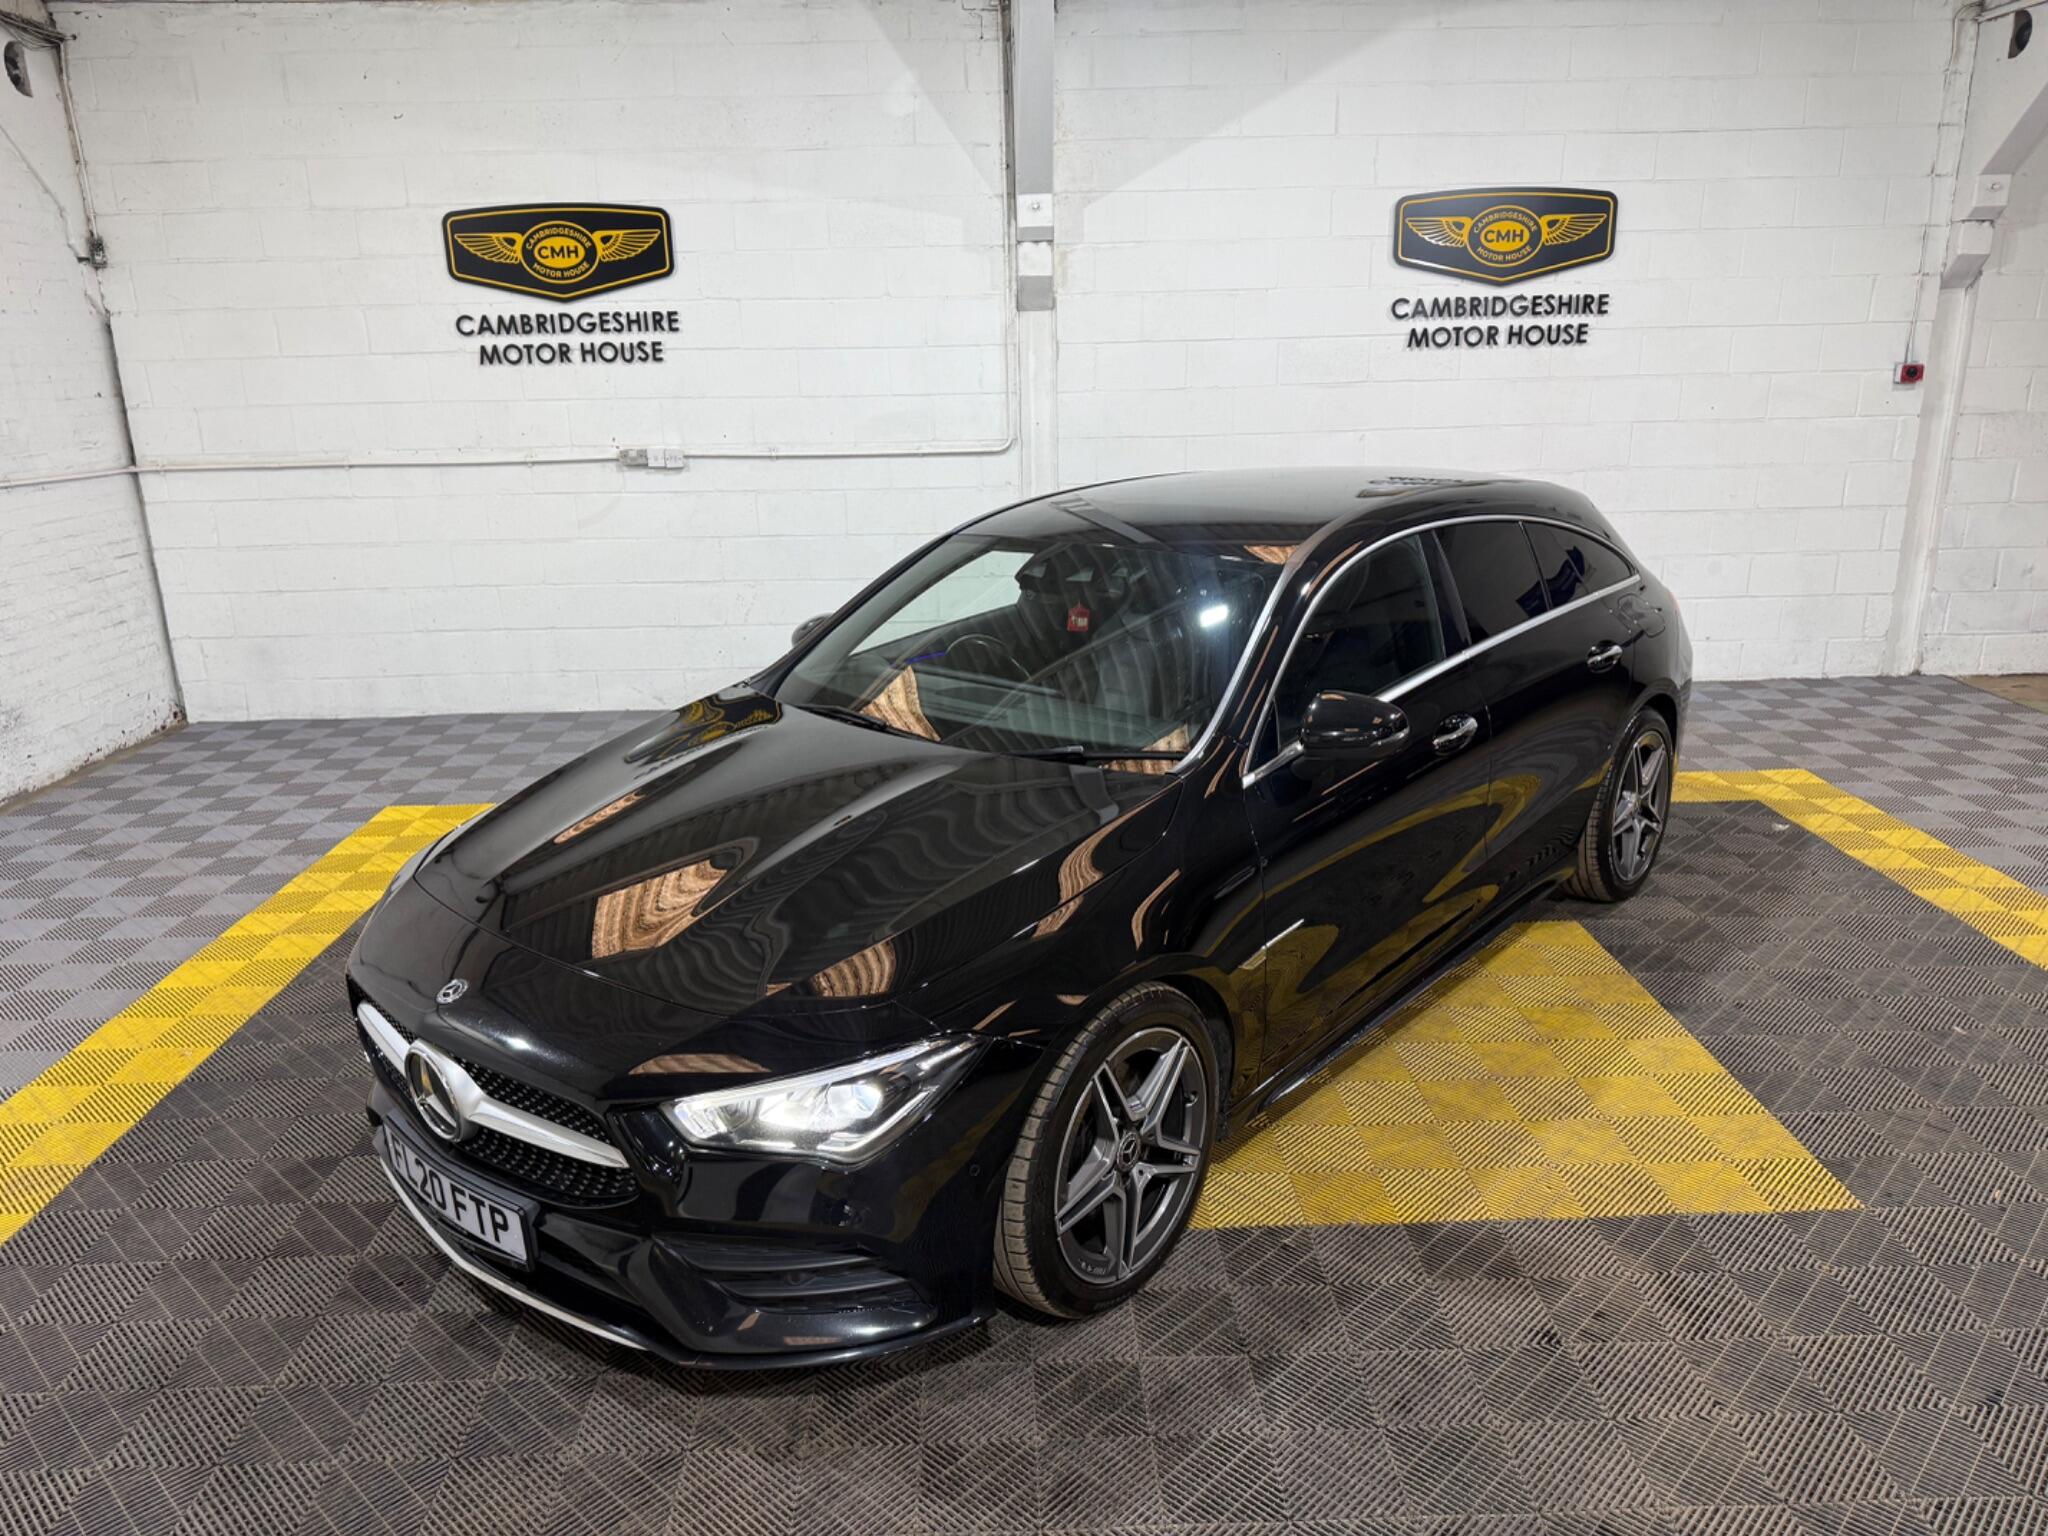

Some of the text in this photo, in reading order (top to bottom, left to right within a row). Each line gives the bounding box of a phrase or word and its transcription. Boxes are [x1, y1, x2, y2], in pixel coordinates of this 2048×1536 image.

[1473, 211, 1537, 233] CAMBRIDGESHIRE
[526, 227, 592, 250] CAMBRIDGESHIRE
[1484, 229, 1524, 243] CMH
[538, 245, 579, 259] CMH
[1477, 245, 1533, 261] MOTOR HOUSE
[533, 261, 590, 278] MOTOR HOUSE
[1391, 294, 1609, 319] CAMBRIDGESHIRE
[455, 311, 679, 336] CAMBRIDGESHIRE
[1407, 323, 1588, 348] MOTOR HOUSE
[479, 341, 664, 365] MOTOR HOUSE
[391, 1133, 509, 1243] FL20 FTP
